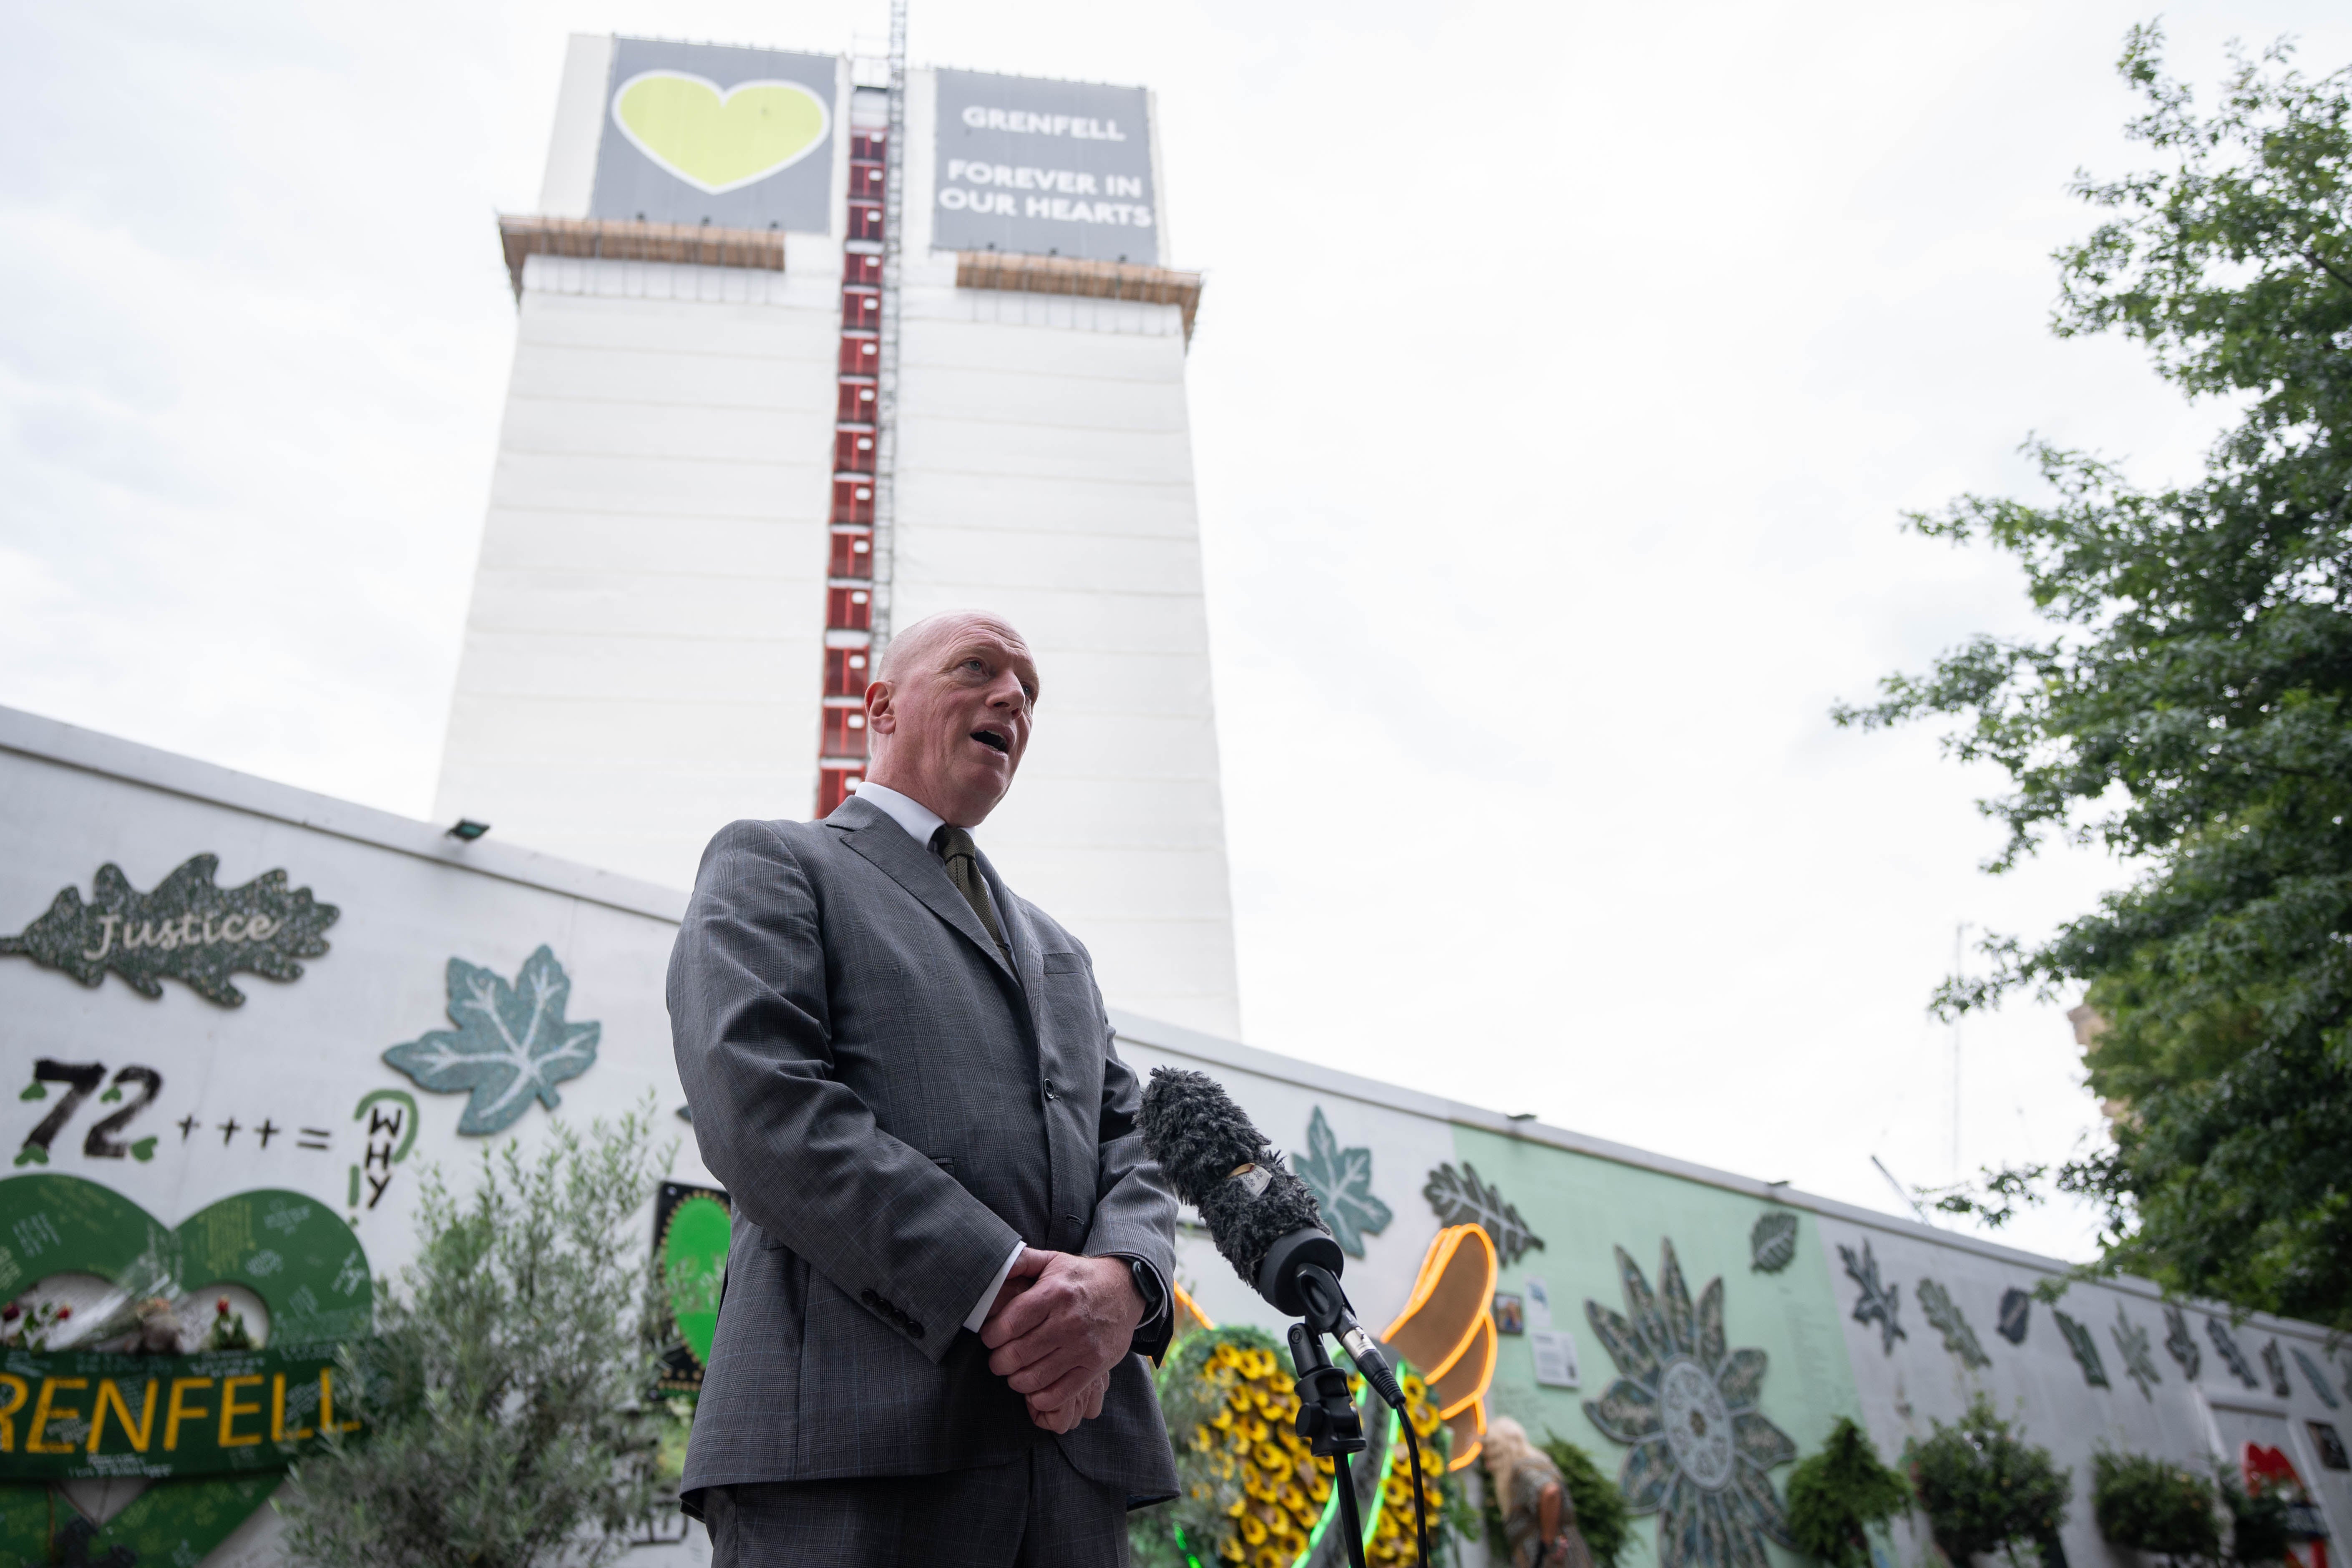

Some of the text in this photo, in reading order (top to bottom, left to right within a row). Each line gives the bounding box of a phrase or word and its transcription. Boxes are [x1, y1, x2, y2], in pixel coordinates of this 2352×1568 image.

[962, 106, 1126, 142] GRENFELL
[948, 159, 1142, 198] FOREVER IN
[938, 187, 1153, 228] OUR HEARTS
[84, 912, 283, 960] Justice
[21, 1057, 163, 1158] 72
[364, 1106, 402, 1209] WHY
[1251, 1169, 1263, 1180] cote
